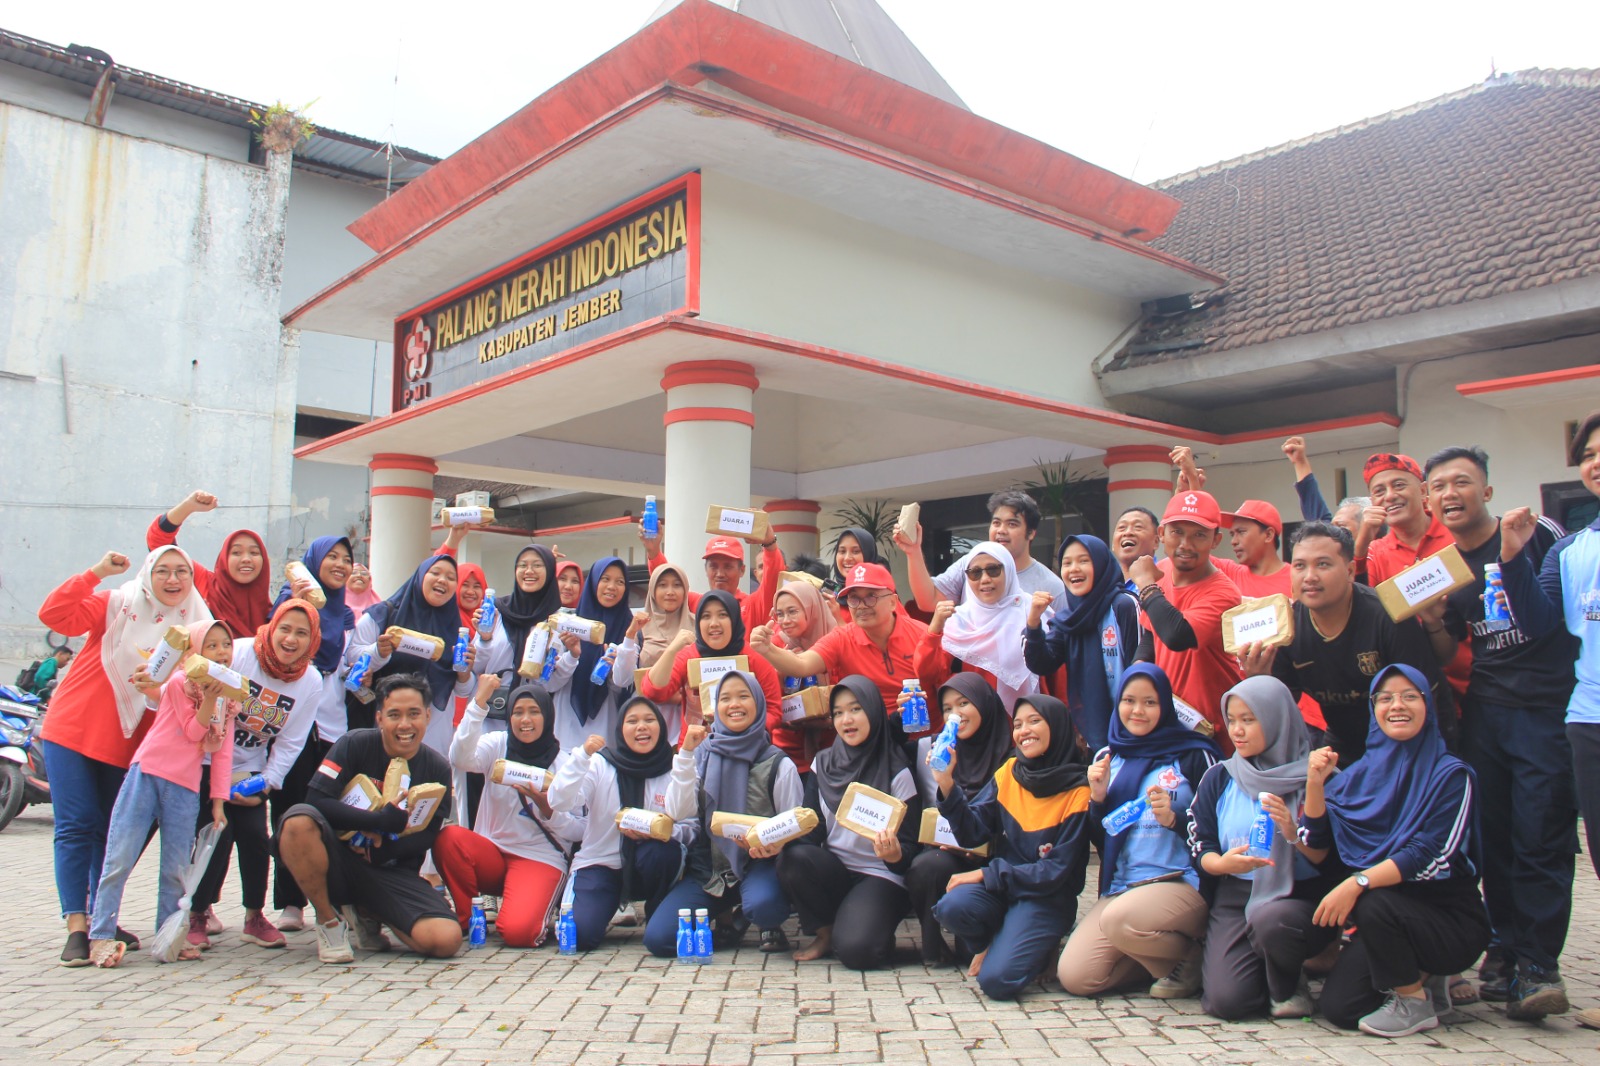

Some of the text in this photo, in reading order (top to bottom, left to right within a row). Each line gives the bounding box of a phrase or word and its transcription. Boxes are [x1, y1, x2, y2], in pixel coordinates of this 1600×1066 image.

[436, 199, 688, 350] PALANG MERAH INDONESIA
[478, 288, 622, 364] KABUPATEN JEMBER
[403, 381, 432, 404] PMI
[722, 516, 745, 525] JUARA
[1405, 573, 1435, 593] JUARA
[1238, 618, 1267, 633] JUARA
[402, 643, 425, 653] JUARA
[529, 632, 539, 654] JUARA
[1101, 647, 1118, 657] PMI
[152, 657, 168, 677] JUARA
[703, 666, 727, 674] JUARA
[782, 705, 798, 715] UARA
[507, 769, 533, 780] JUARA
[413, 804, 425, 824] JUARA
[854, 804, 879, 820] JUARA
[1114, 806, 1140, 827] ISOPLUS
[761, 821, 787, 837] JUARA
[938, 826, 953, 834] JUA
[1257, 814, 1268, 844] ISOPLUS
[685, 928, 693, 953] ISOPLUS
[697, 928, 705, 953] ISOPLUS
